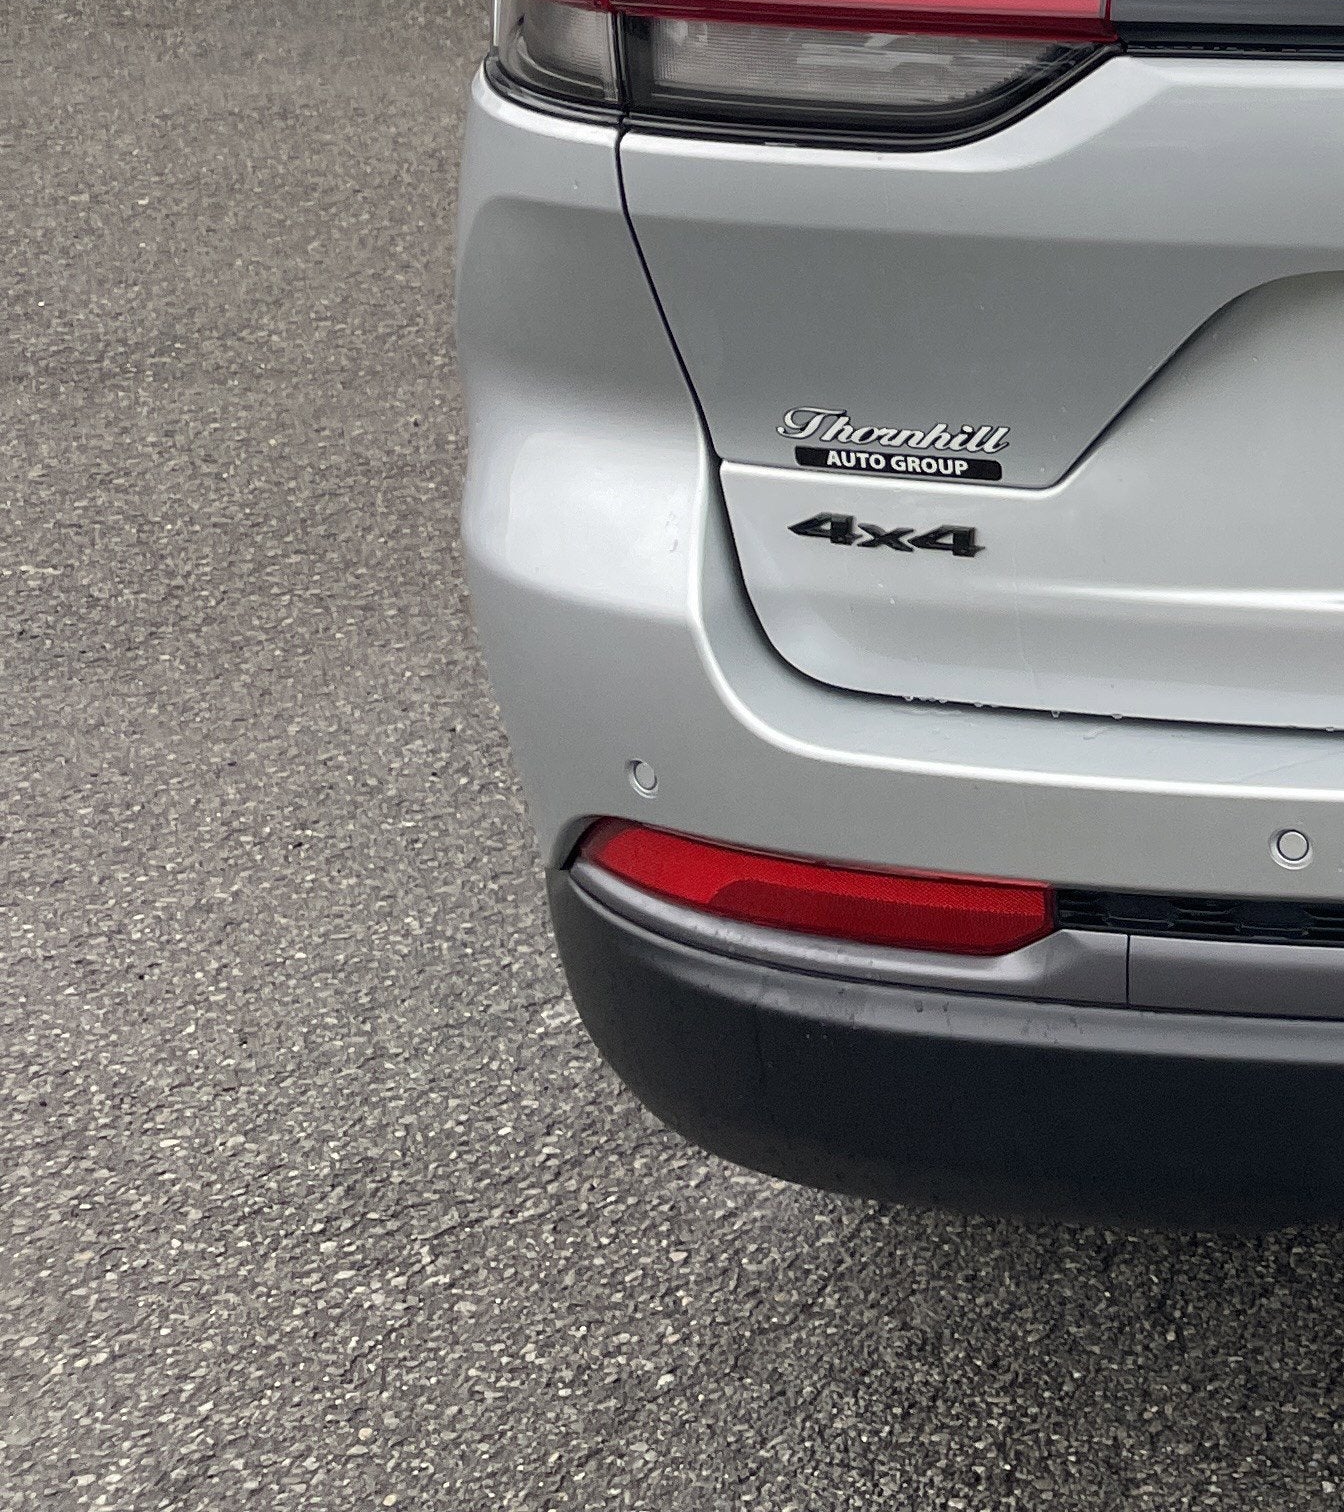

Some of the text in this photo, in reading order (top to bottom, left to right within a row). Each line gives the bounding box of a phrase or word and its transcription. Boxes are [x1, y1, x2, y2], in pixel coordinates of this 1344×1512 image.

[776, 406, 1010, 454] Thornhill
[826, 450, 969, 476] AUTO GROUP
[787, 511, 986, 558] 4x4
